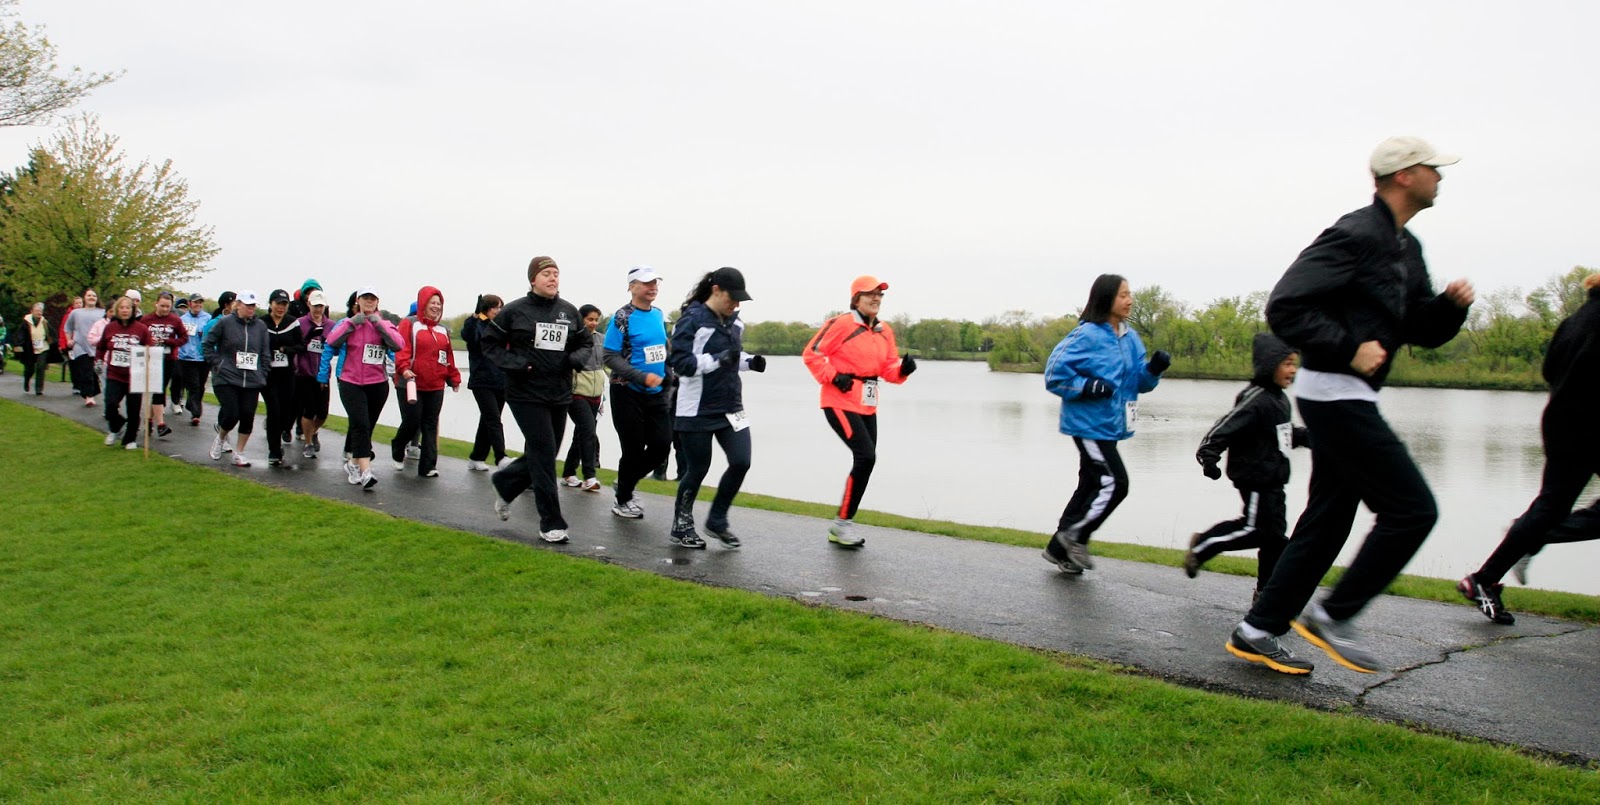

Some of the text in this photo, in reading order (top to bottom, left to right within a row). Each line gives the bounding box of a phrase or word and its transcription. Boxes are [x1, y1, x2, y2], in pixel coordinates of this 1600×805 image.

[541, 329, 562, 343] 268
[368, 349, 383, 359] 315
[650, 351, 664, 362] 385
[241, 356, 254, 365] 355
